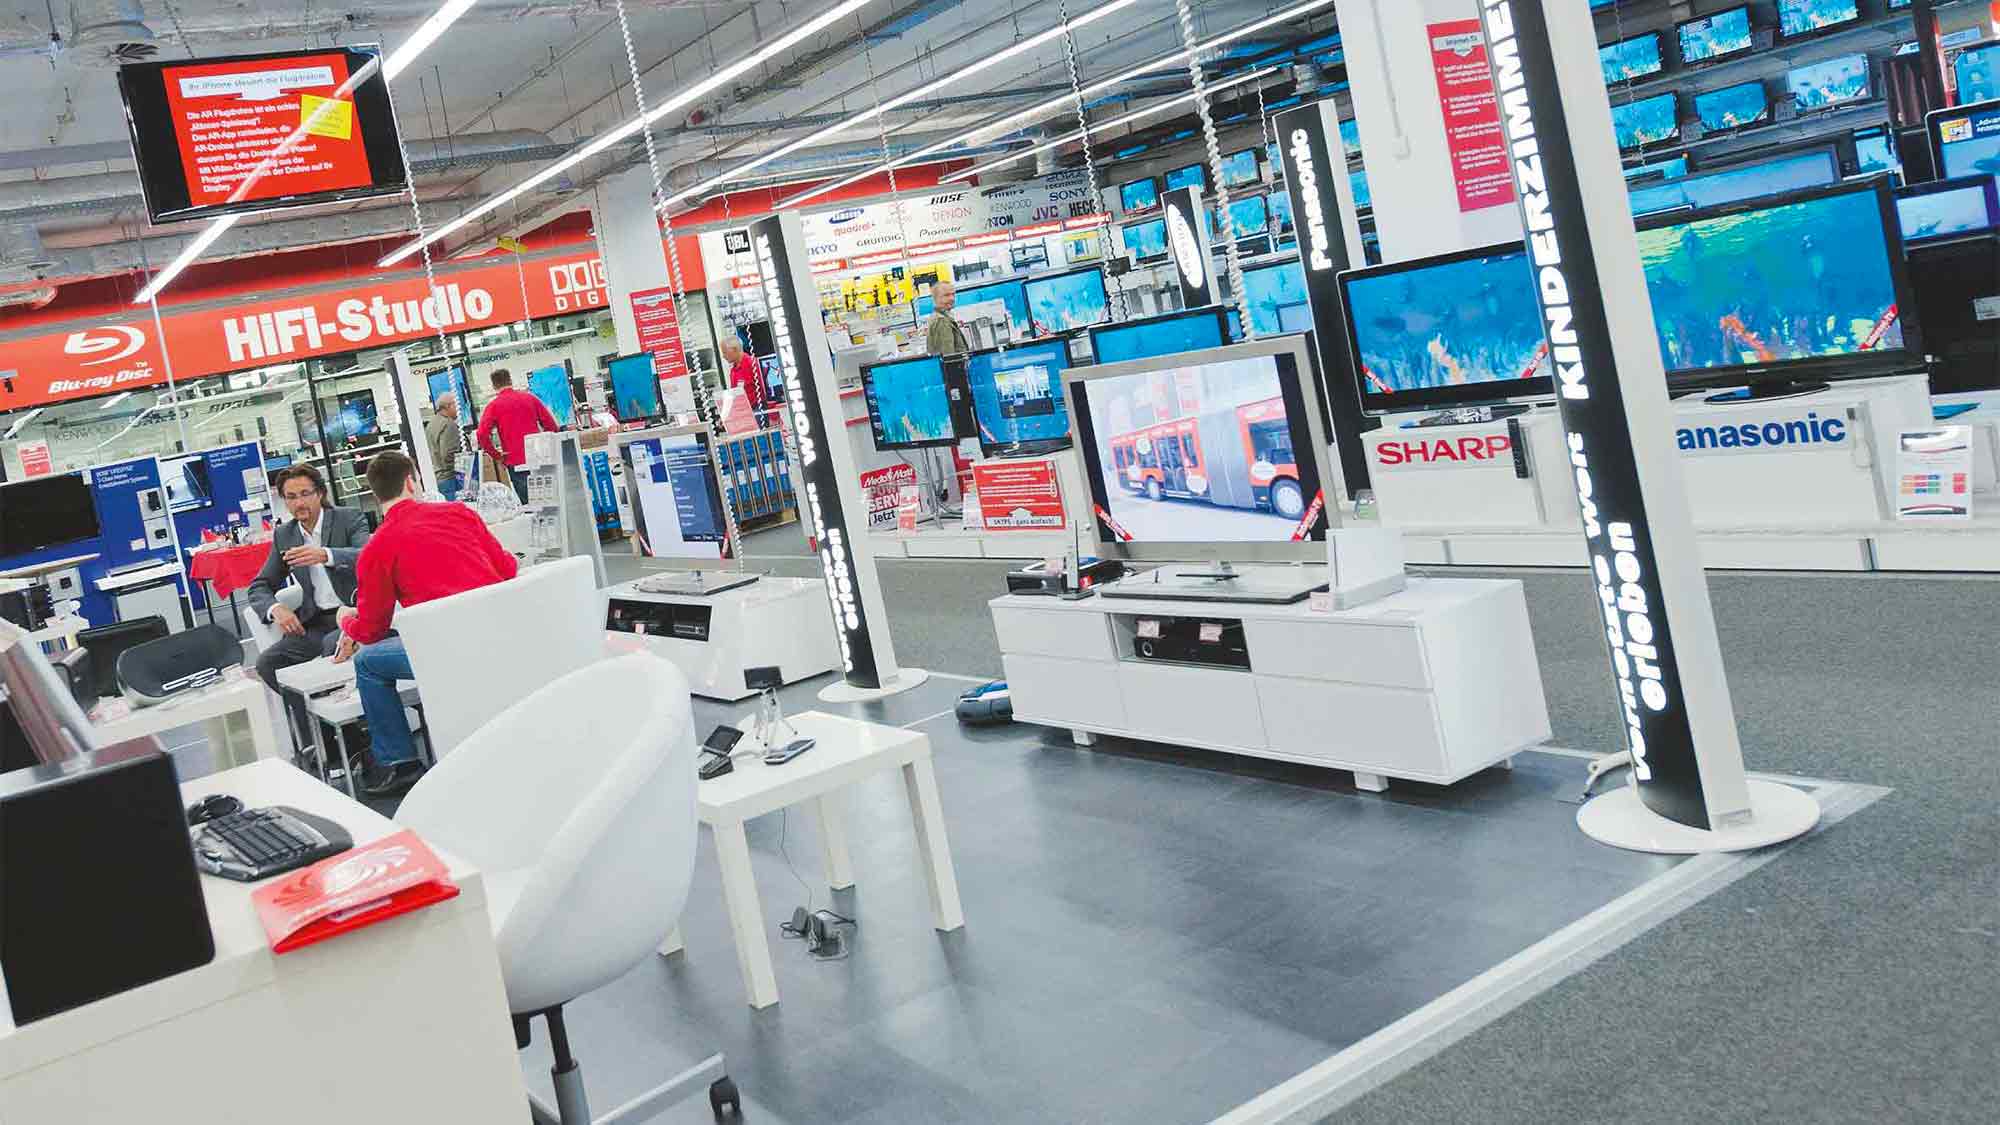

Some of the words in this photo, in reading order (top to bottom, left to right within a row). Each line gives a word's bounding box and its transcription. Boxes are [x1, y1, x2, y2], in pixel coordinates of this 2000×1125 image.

[1049, 187, 1088, 202] SONY
[1290, 128, 1332, 271] Panasonic
[1484, 0, 1589, 399] KINDERZIMME
[1032, 205, 1059, 221] JVC
[856, 232, 904, 247] GRUNDIG
[919, 225, 961, 239] Pioneer
[223, 283, 494, 363] HiFi-Studio
[756, 233, 817, 466] WOHNZIMMER
[48, 374, 114, 395] Blu-ray
[1675, 411, 1847, 451] anasonic
[1376, 435, 1512, 466] SHARP
[873, 509, 896, 524] Jetzt
[1607, 521, 1667, 711] erleben
